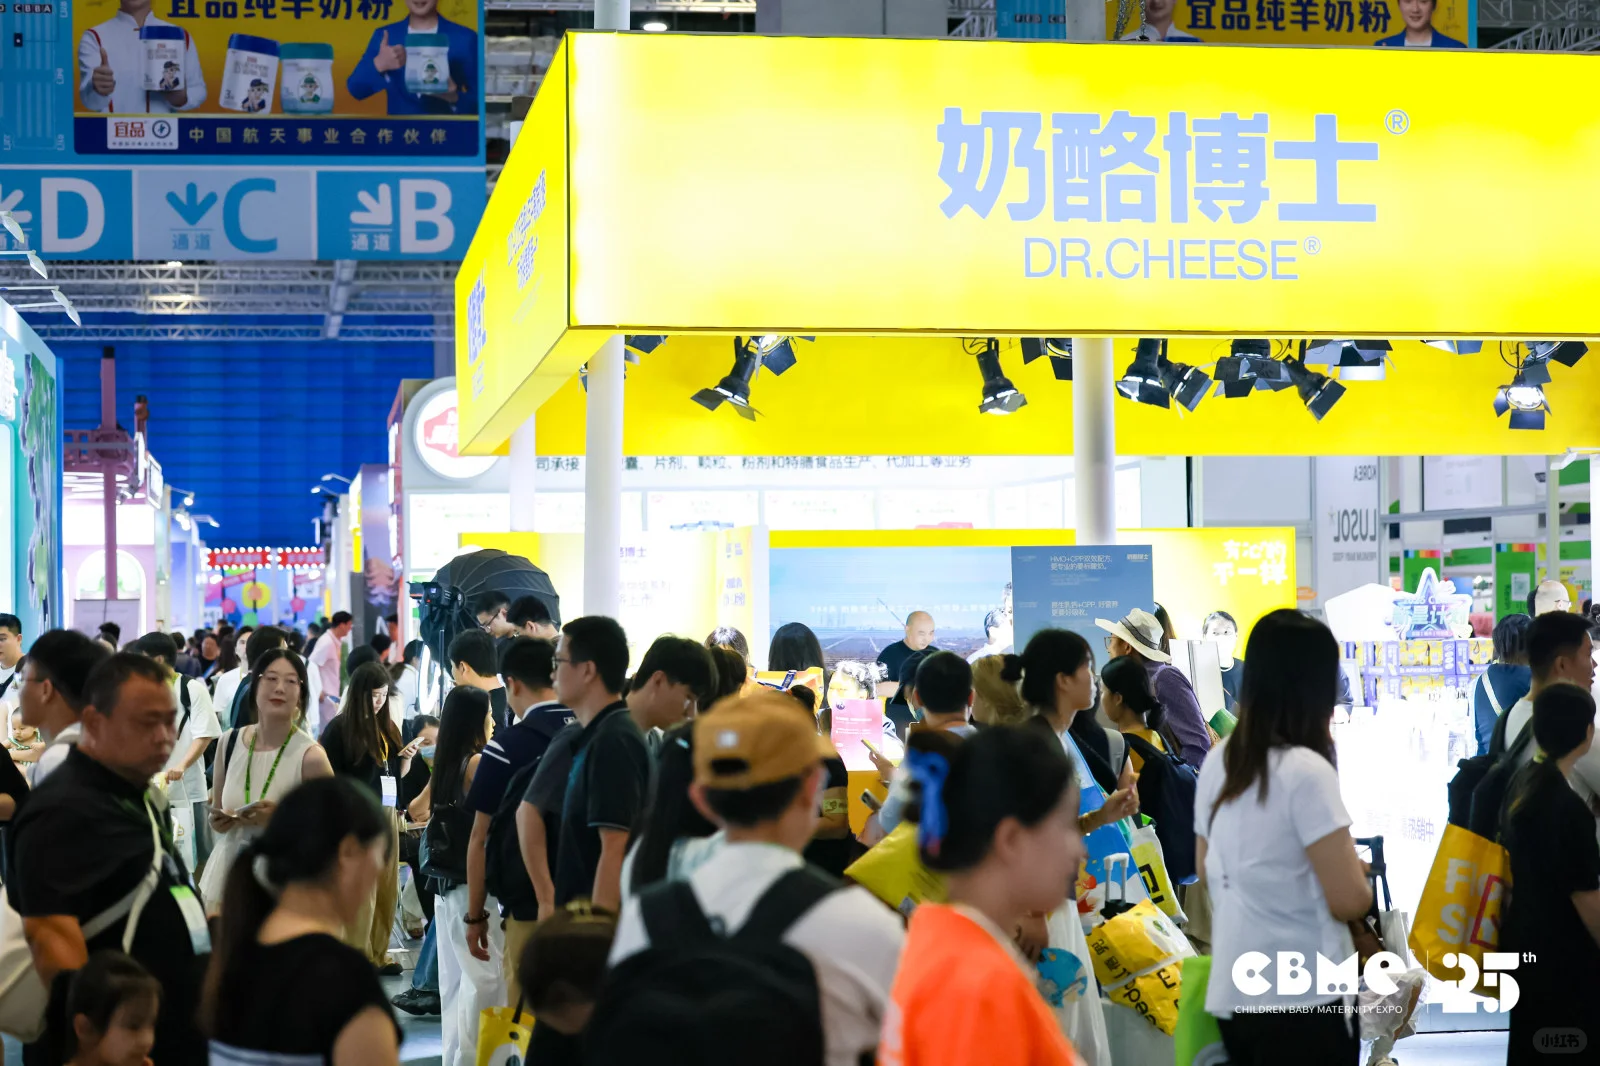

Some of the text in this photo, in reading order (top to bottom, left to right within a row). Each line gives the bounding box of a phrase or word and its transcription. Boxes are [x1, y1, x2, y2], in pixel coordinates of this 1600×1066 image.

[1187, 0, 1392, 33] 宜品纯羊奶粉
[114, 121, 145, 138] 宜品
[189, 126, 448, 145] 中国航天事业合作伙伴
[936, 106, 1379, 225] 奶酪博士
[41, 178, 105, 253] D
[223, 178, 278, 253] C
[399, 178, 456, 254] B
[171, 233, 211, 251] 通道
[351, 233, 391, 252] 通道
[1024, 236, 1299, 281] DR.CHEESE
[536, 456, 580, 471] 司承接
[1212, 560, 1289, 585] 不一样
